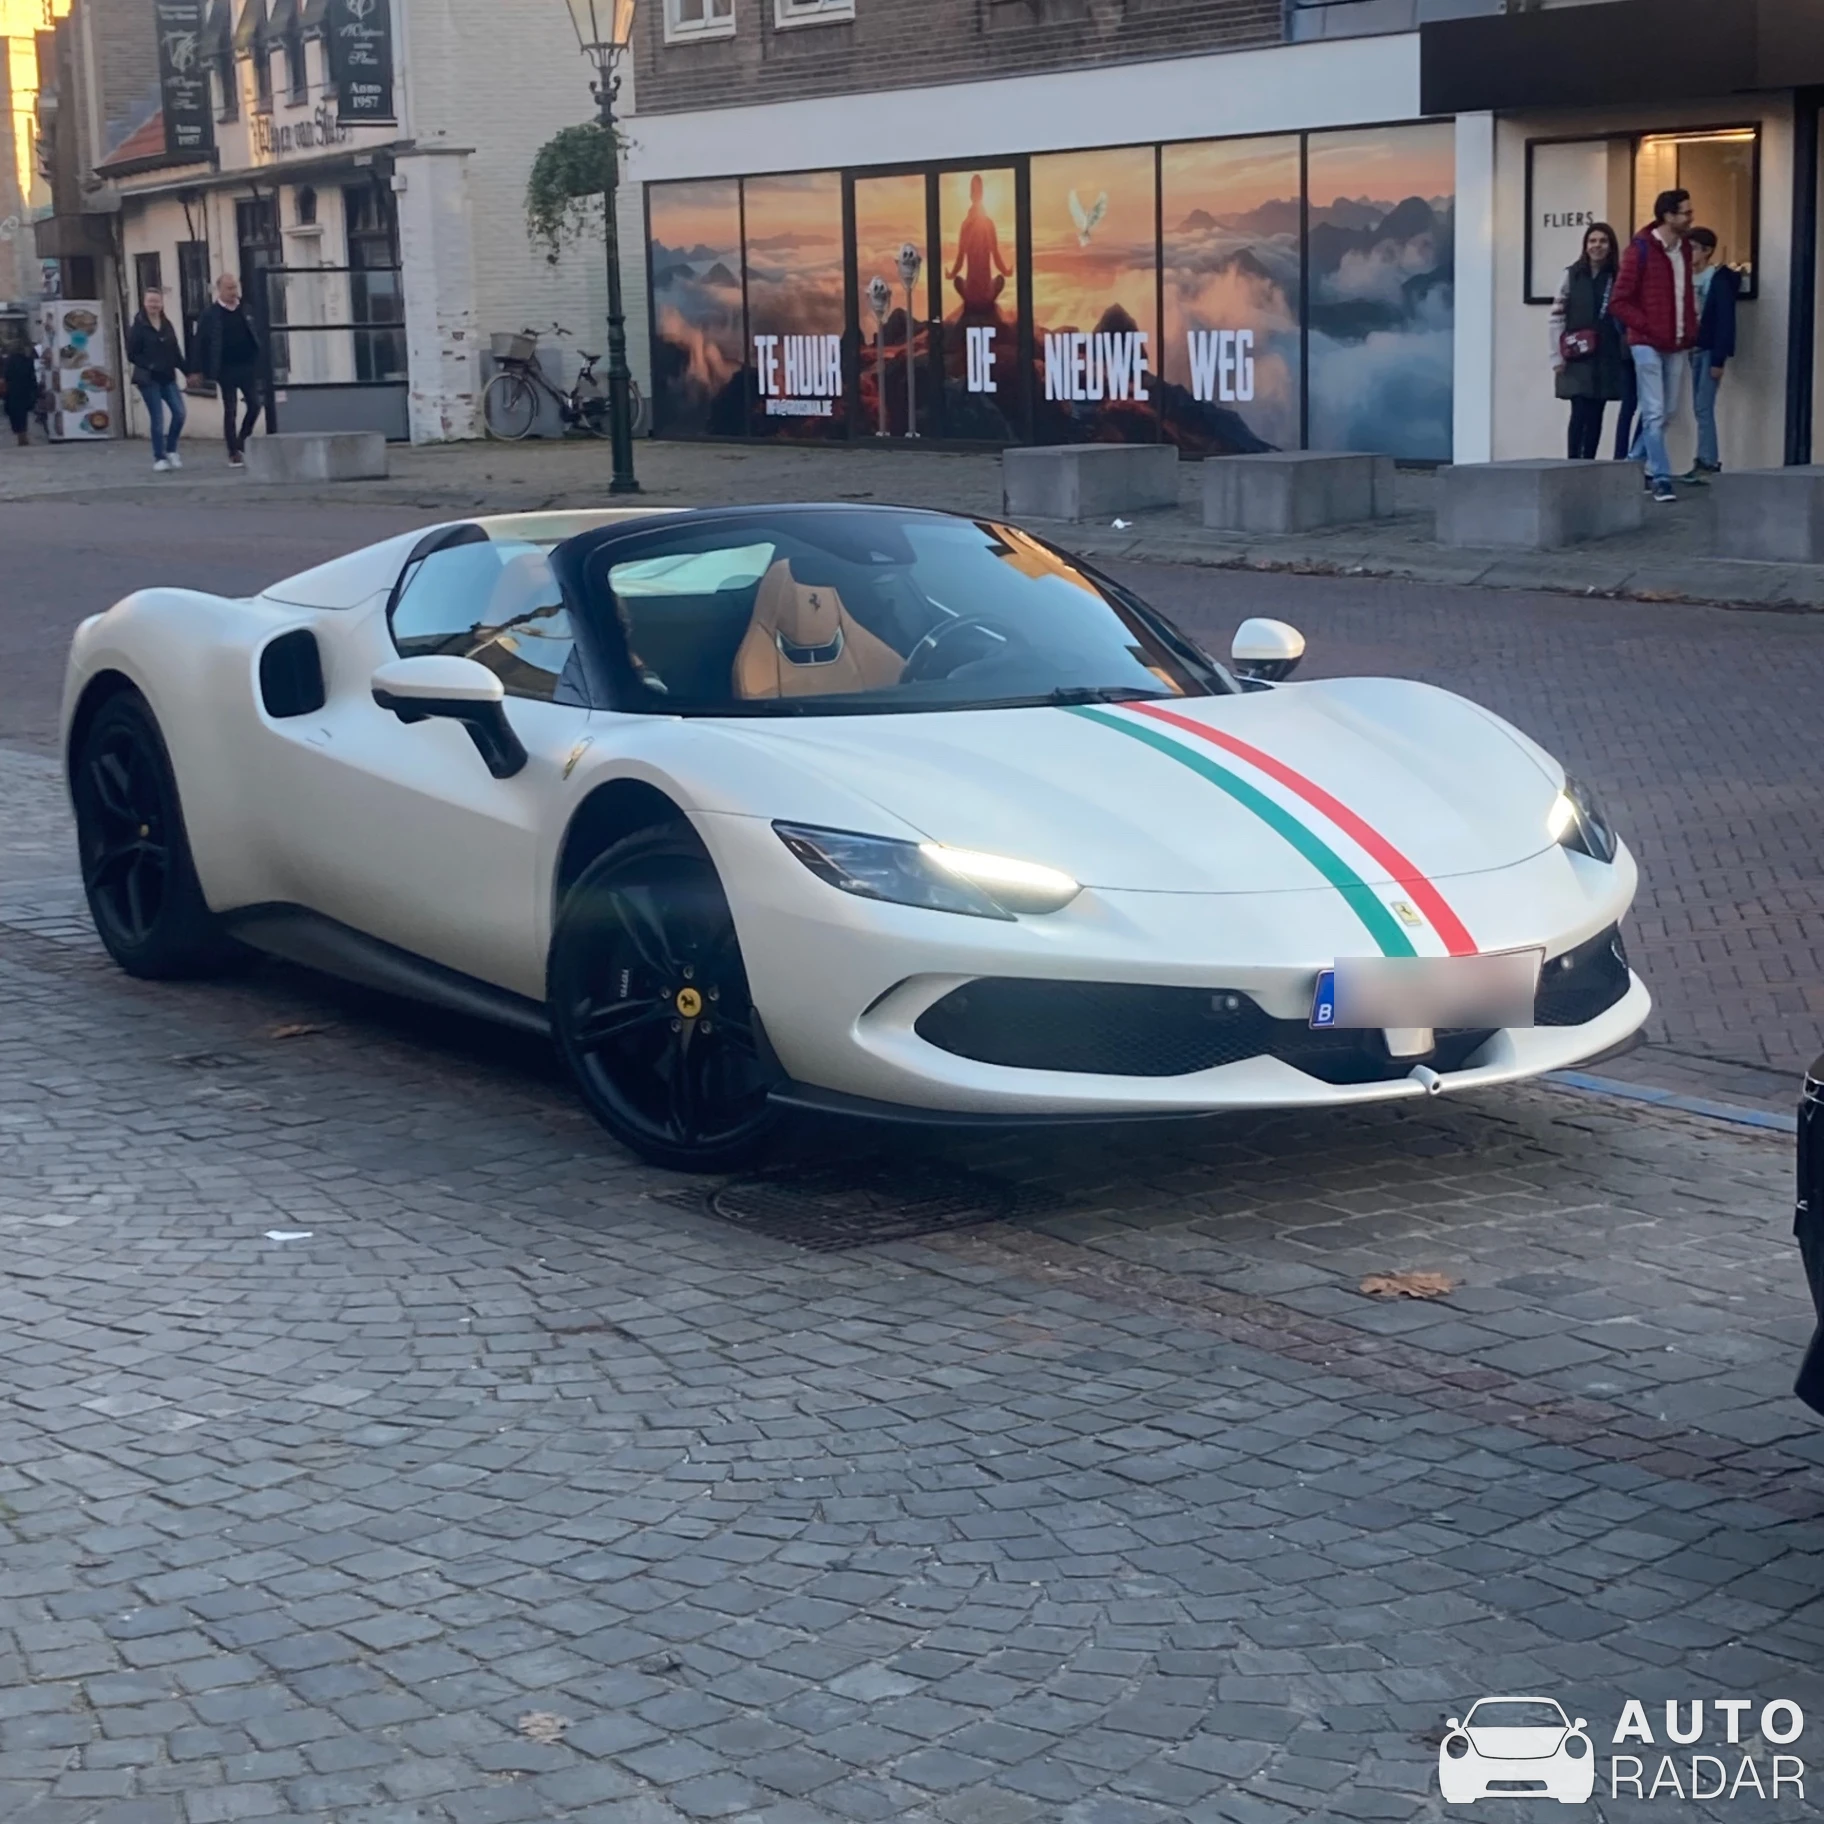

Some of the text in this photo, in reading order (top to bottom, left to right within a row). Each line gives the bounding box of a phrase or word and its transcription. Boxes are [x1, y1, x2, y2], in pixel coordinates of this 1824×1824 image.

[349, 81, 382, 94] Anno
[352, 95, 379, 108] 1957
[1543, 211, 1593, 228] FLIERS
[754, 334, 842, 397] TE HUUR
[966, 326, 1254, 401] DE NIEUWE WEG
[1317, 1003, 1332, 1022] B
